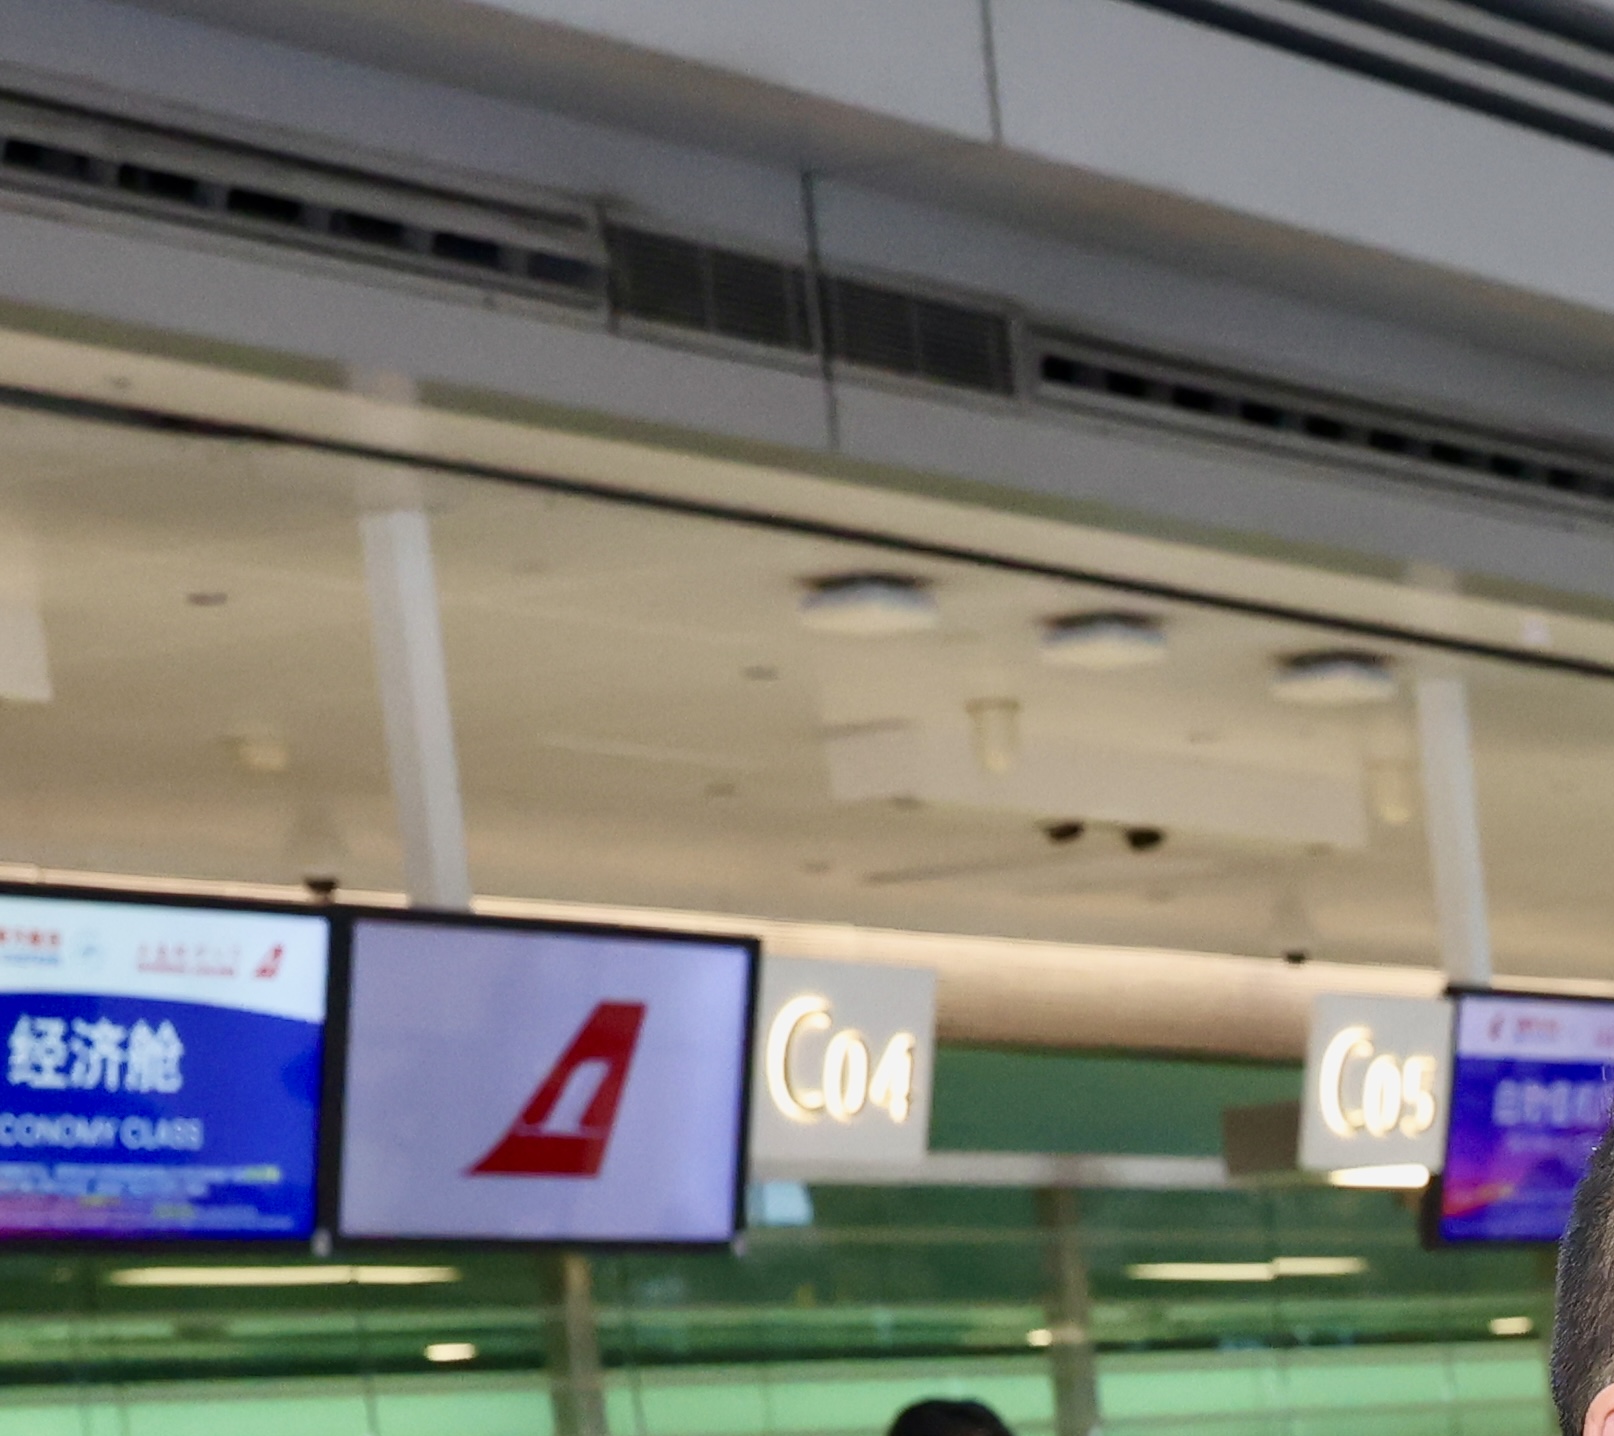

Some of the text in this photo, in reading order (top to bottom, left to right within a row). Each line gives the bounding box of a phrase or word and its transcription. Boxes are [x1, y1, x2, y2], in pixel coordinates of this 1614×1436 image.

[7, 1013, 184, 1094] 经济舱
[766, 995, 915, 1126] C04
[1319, 1024, 1437, 1139] C05
